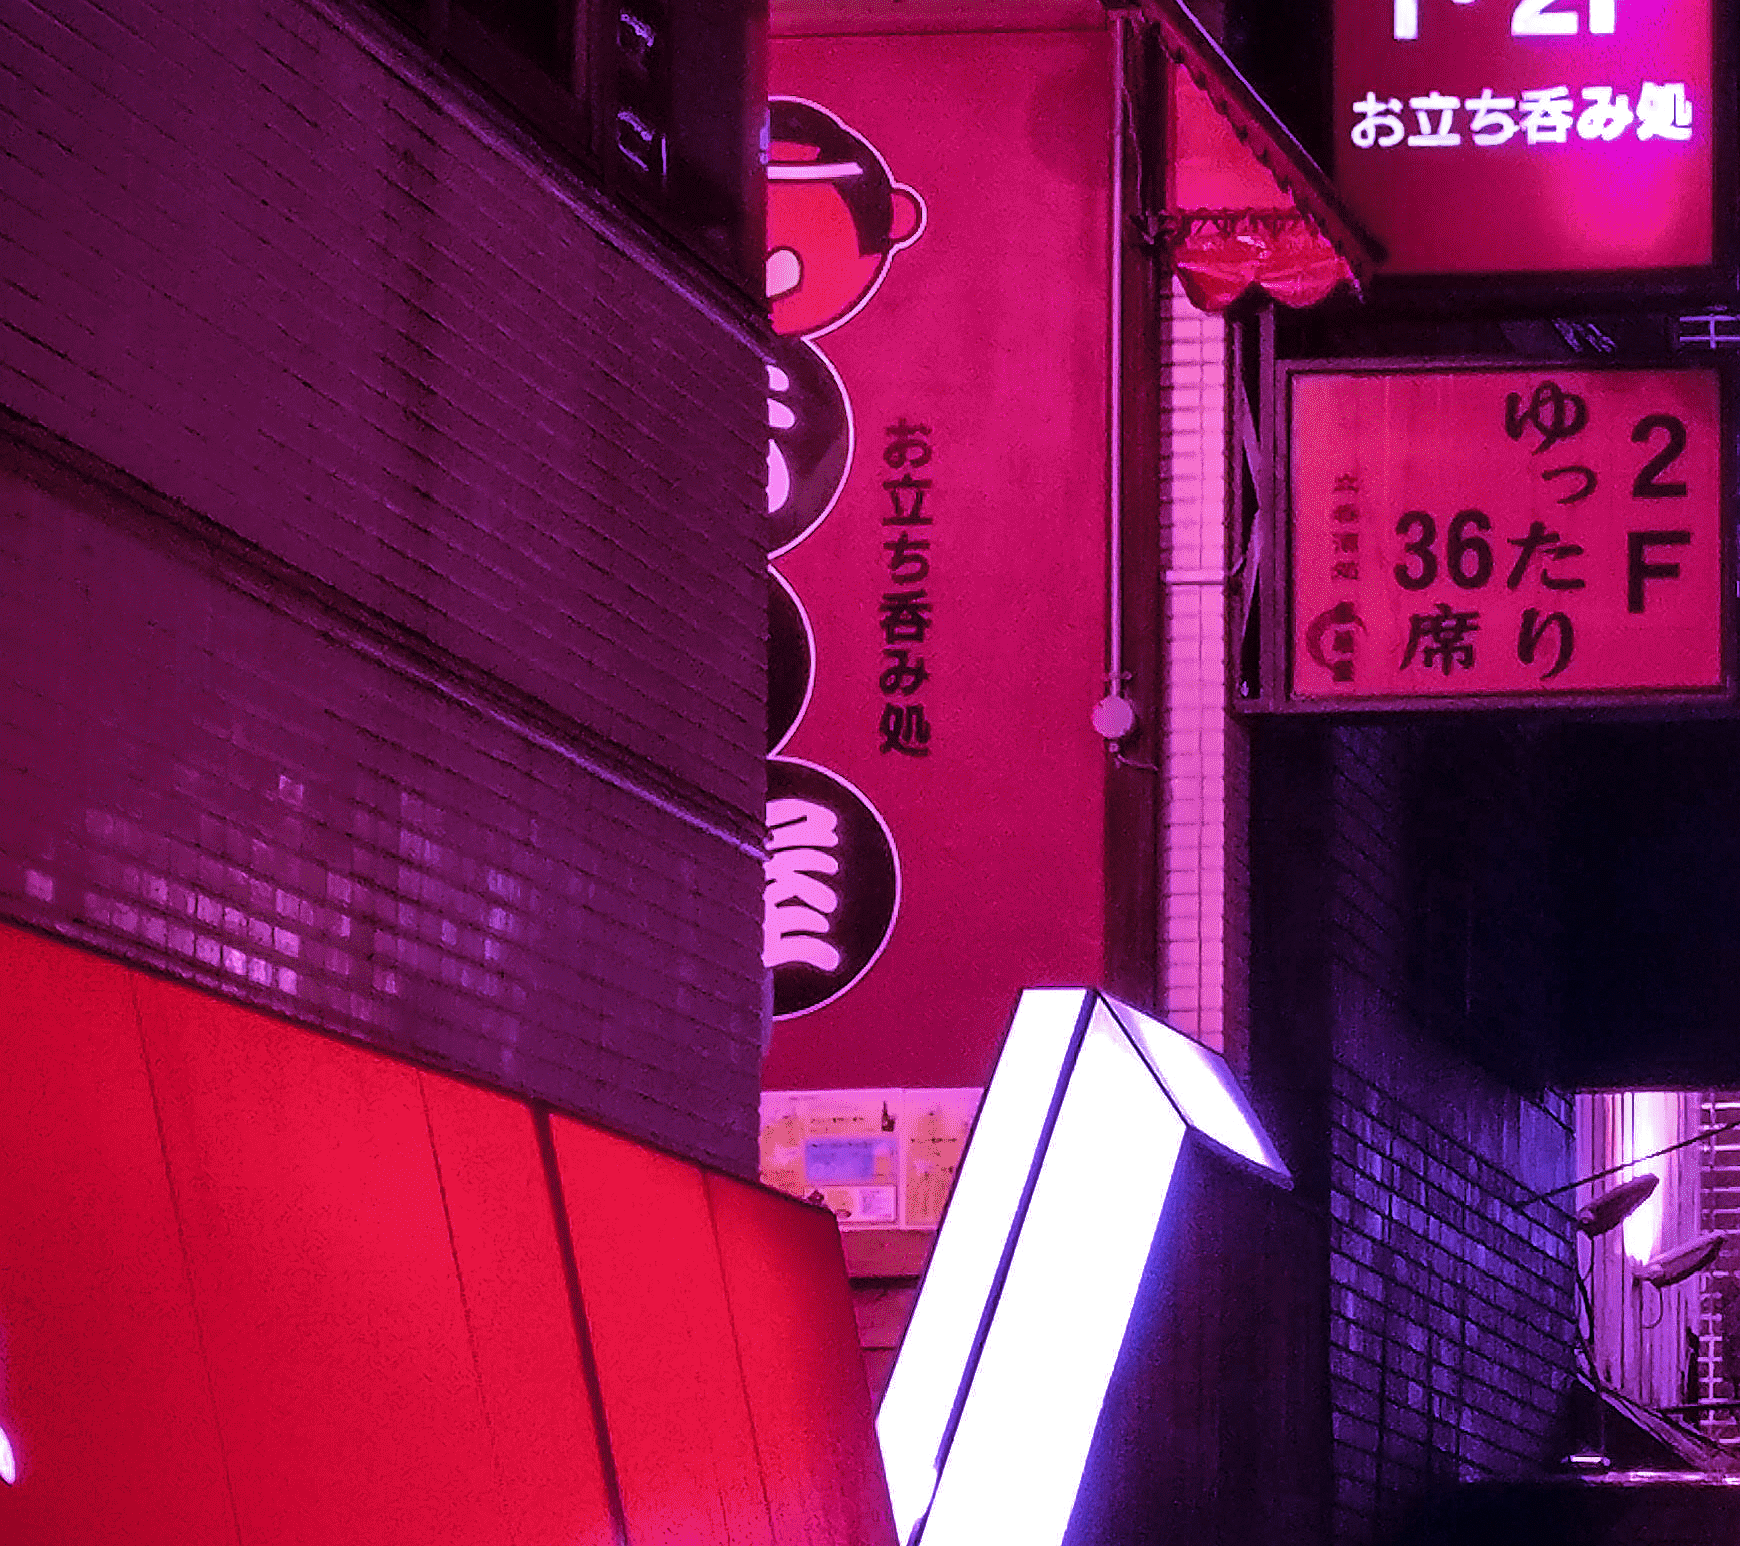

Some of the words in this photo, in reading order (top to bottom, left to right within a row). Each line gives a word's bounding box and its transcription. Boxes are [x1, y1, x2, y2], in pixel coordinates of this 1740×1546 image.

[1350, 81, 1693, 149] お立ち呑み処
[879, 417, 934, 758] お立ち呑み処
[1393, 508, 1495, 677] 36席
[1504, 379, 1597, 681] ゆったり
[1626, 413, 1691, 615] 2F
